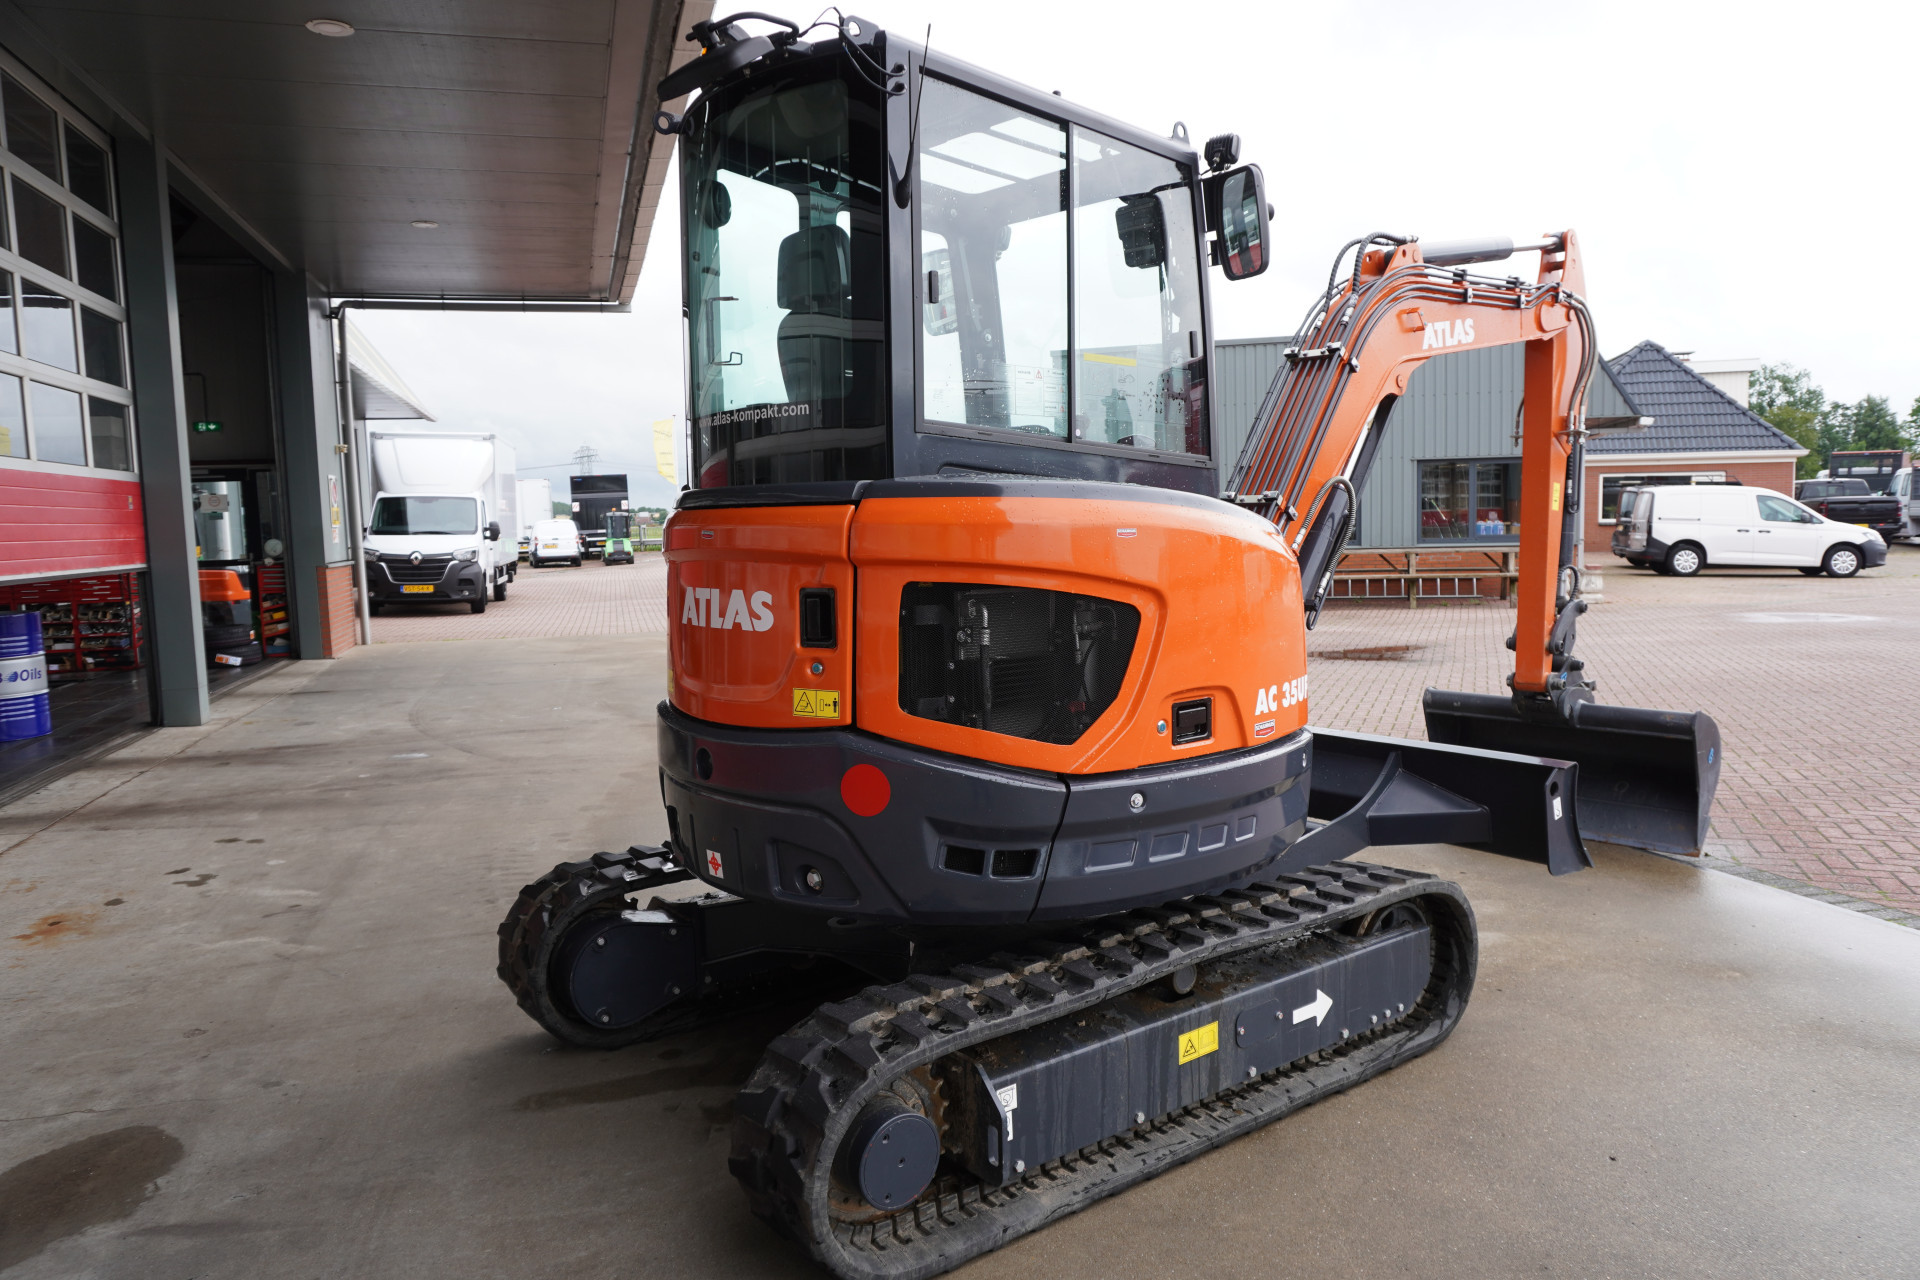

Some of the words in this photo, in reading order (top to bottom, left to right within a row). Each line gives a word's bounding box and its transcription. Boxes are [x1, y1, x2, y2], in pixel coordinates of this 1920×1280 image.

[1422, 317, 1475, 350] ATLAS
[682, 587, 774, 632] ATLAS
[20, 668, 42, 681] Oils
[1255, 685, 1277, 716] AC
